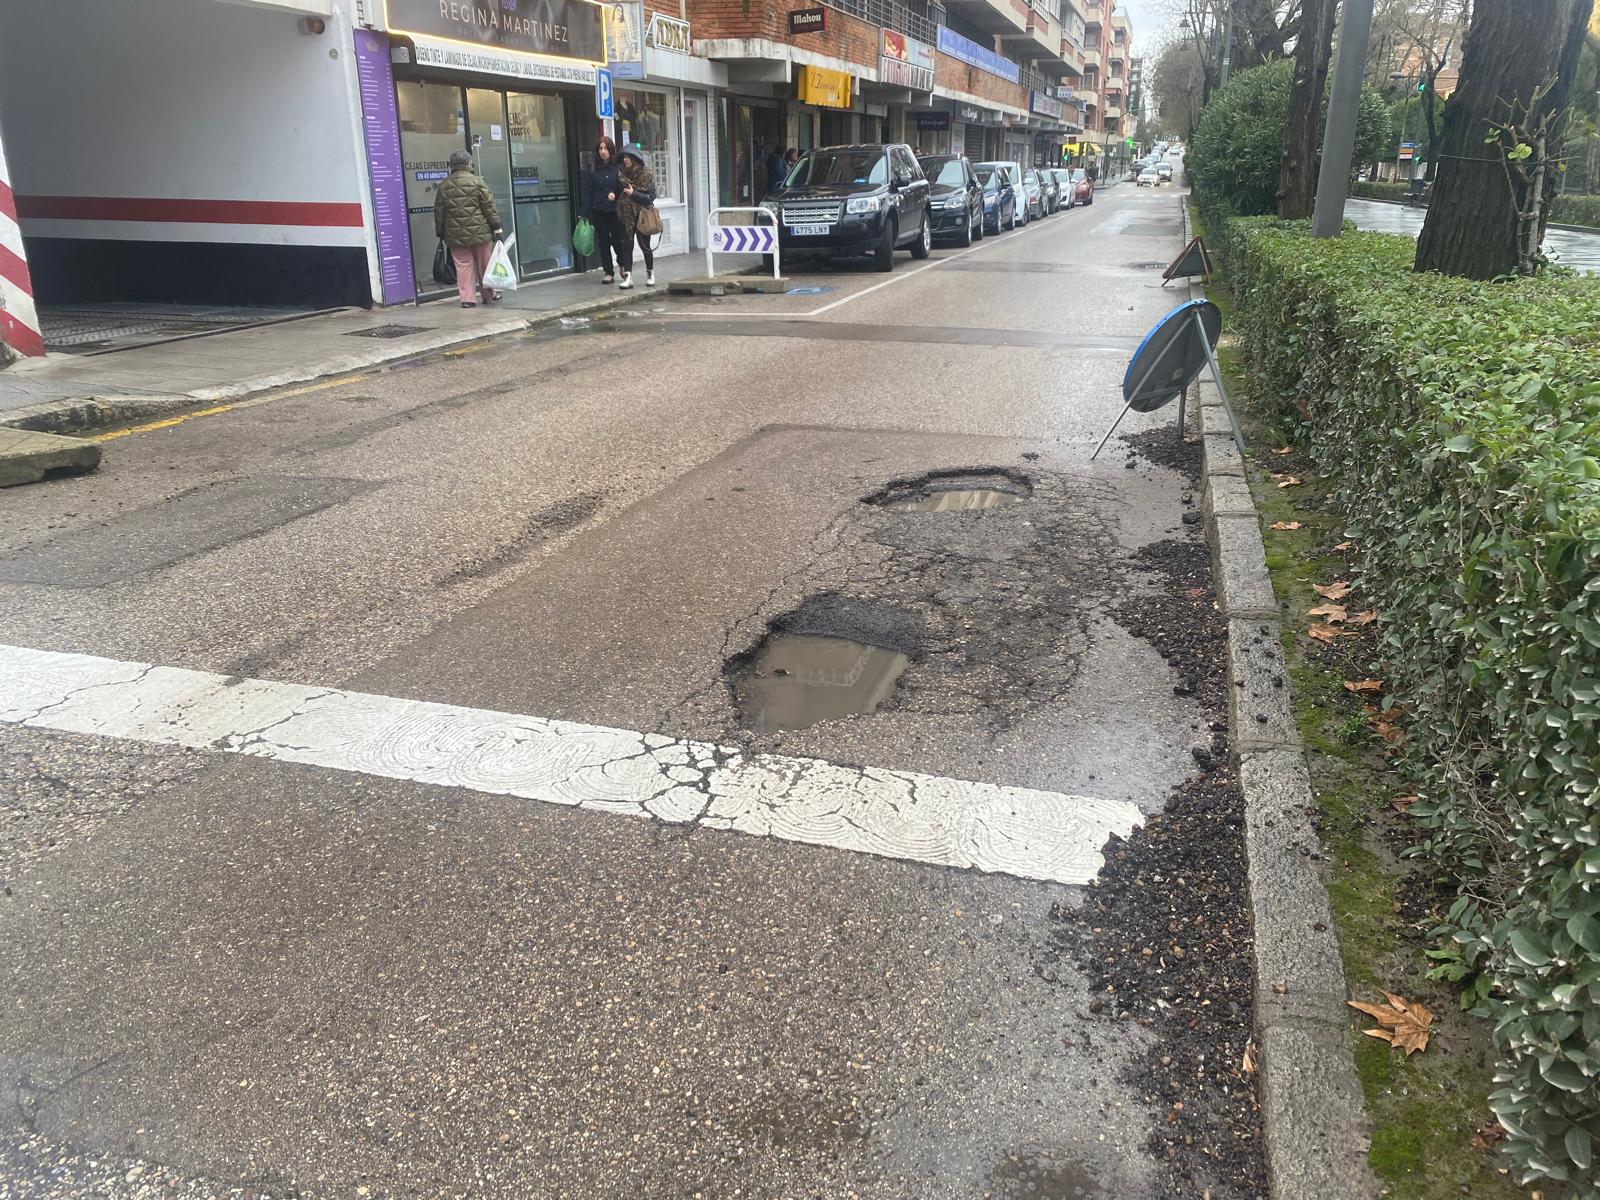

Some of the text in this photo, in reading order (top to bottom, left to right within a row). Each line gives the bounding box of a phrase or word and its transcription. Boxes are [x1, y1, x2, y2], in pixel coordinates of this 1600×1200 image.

[440, 1, 498, 28] REGINA
[503, 14, 568, 42] MARTINEZ
[794, 13, 821, 24] Mahou
[601, 74, 609, 112] P
[405, 161, 422, 170] CEJAS
[423, 160, 446, 169] EXPRESS
[795, 225, 827, 235] 4775 LNY
